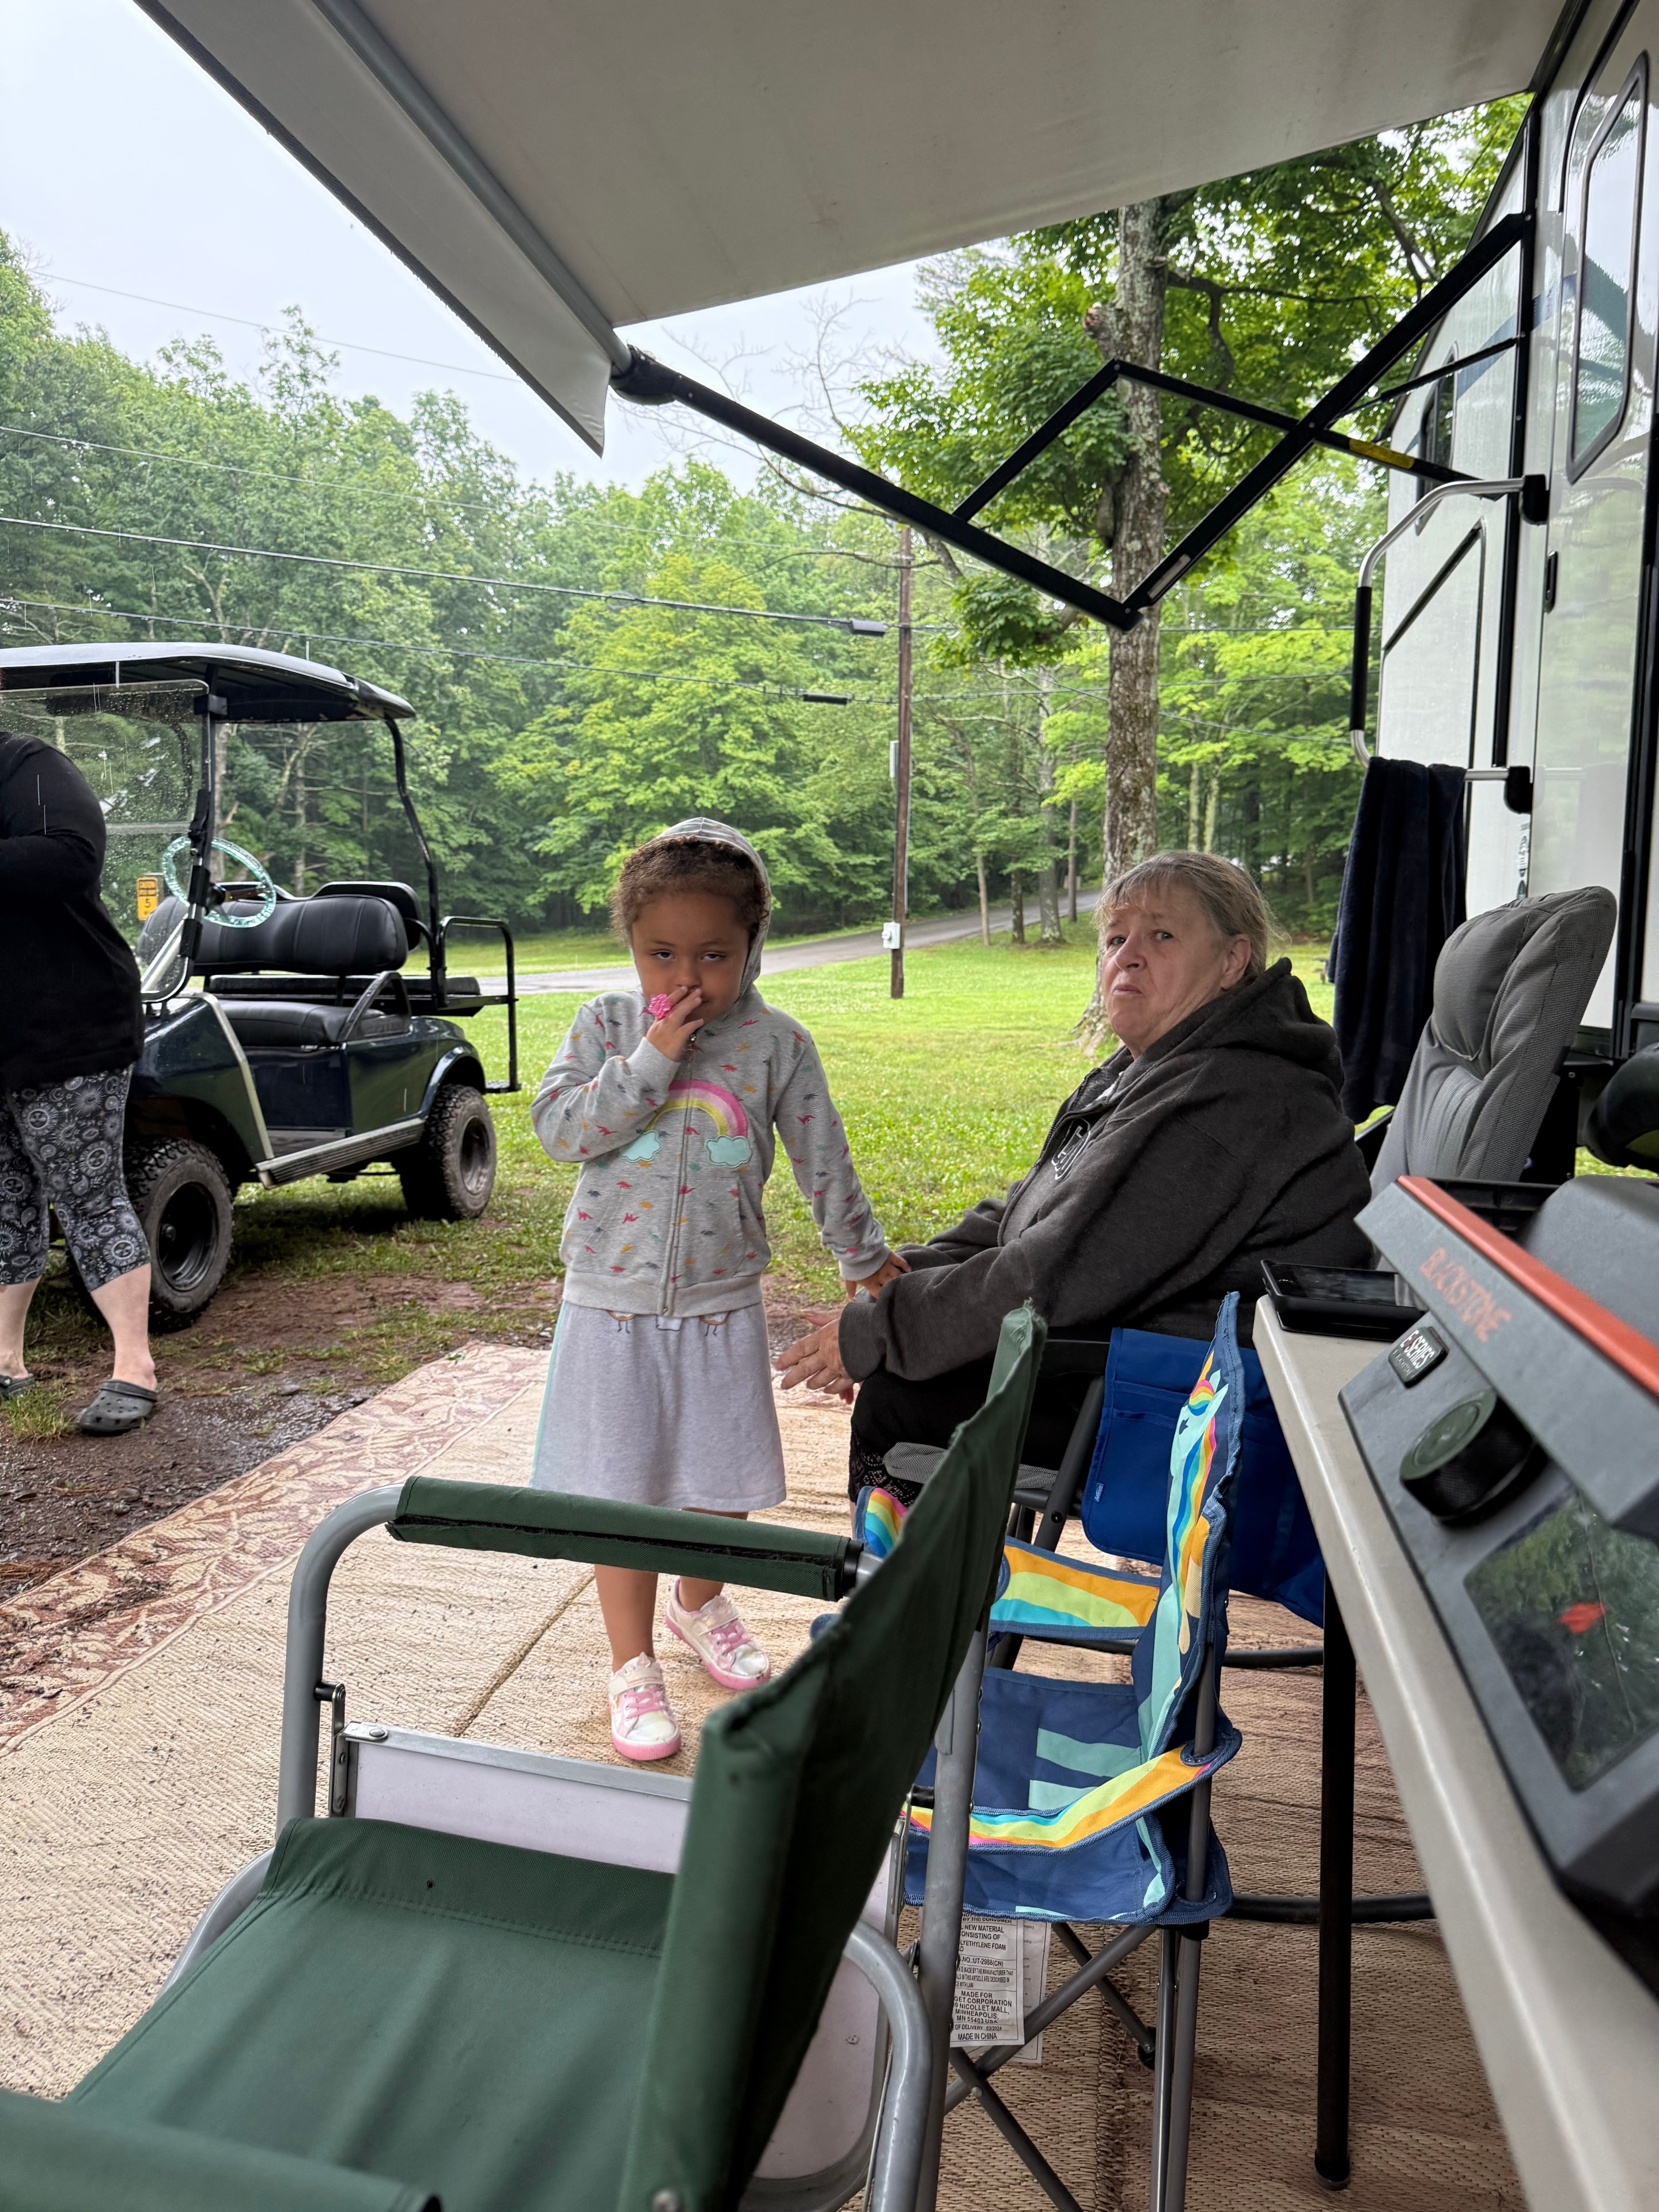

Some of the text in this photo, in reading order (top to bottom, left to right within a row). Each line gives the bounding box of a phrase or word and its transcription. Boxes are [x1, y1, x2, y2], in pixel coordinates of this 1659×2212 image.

[145, 899, 151, 908] 5
[978, 1925, 1004, 1933] MATERIAL
[961, 1931, 991, 1940] ONSISTING
[960, 1940, 991, 1949] LYETHYLENE
[967, 1998, 1012, 2007] CORPORATION
[960, 2003, 990, 2011] NICOLLET
[991, 2006, 1009, 2014] MALL,
[955, 2009, 999, 2020] MINNEAPOLIS,
